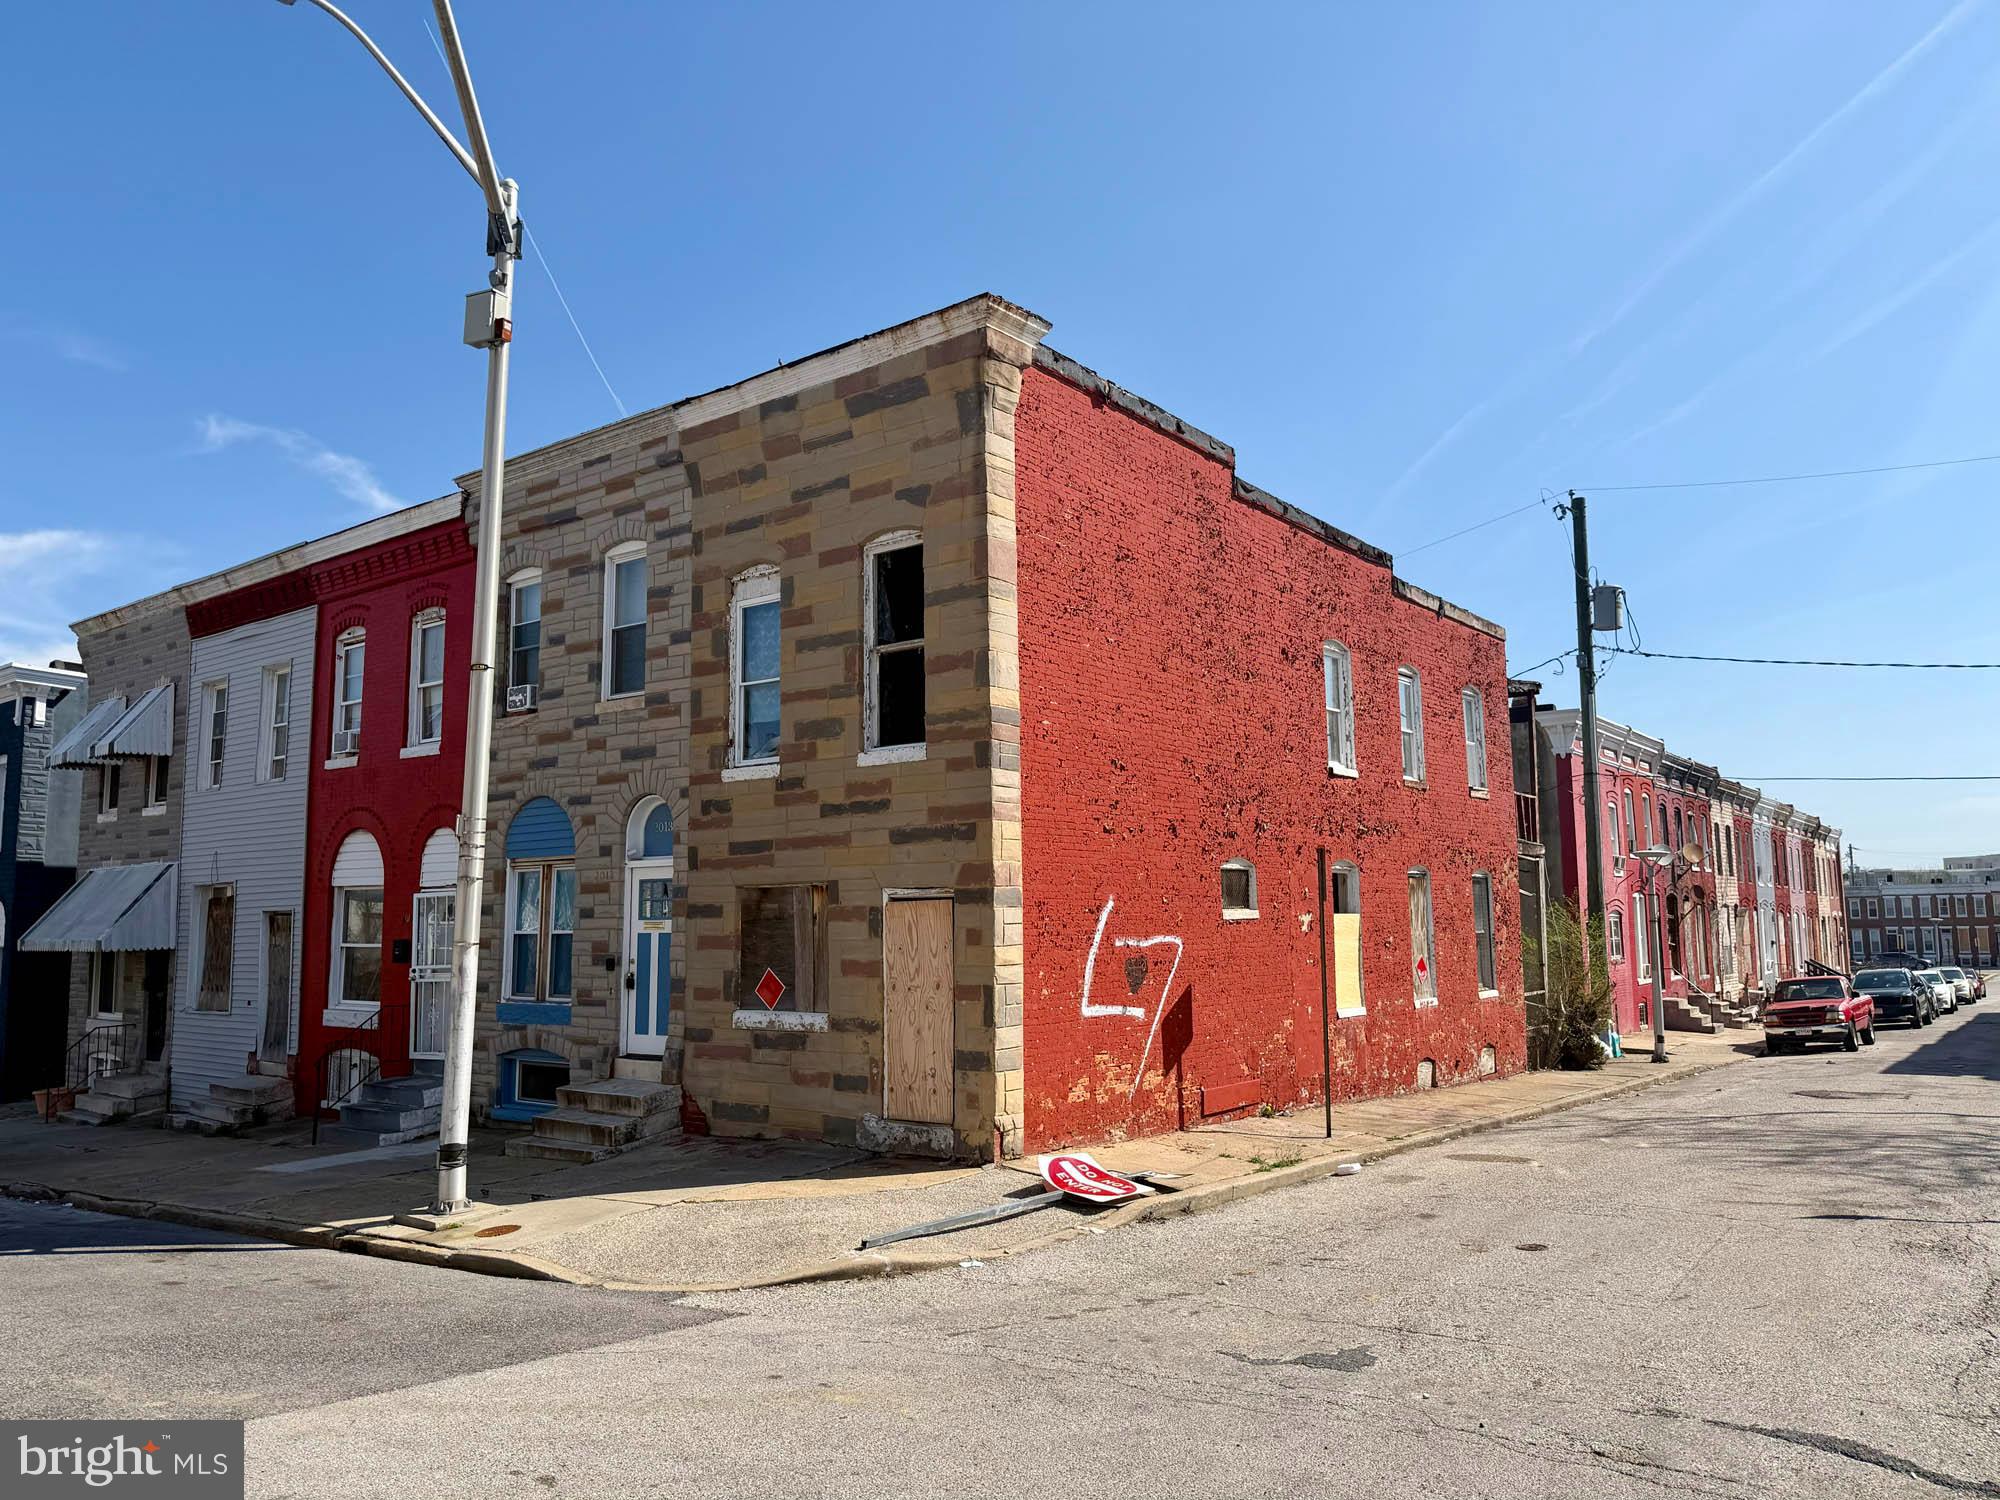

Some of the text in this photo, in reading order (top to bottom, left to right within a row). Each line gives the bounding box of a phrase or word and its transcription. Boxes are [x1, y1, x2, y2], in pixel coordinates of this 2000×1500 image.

[1056, 1171, 1103, 1194] ENTER
[1076, 1163, 1133, 1190] DO NOT
